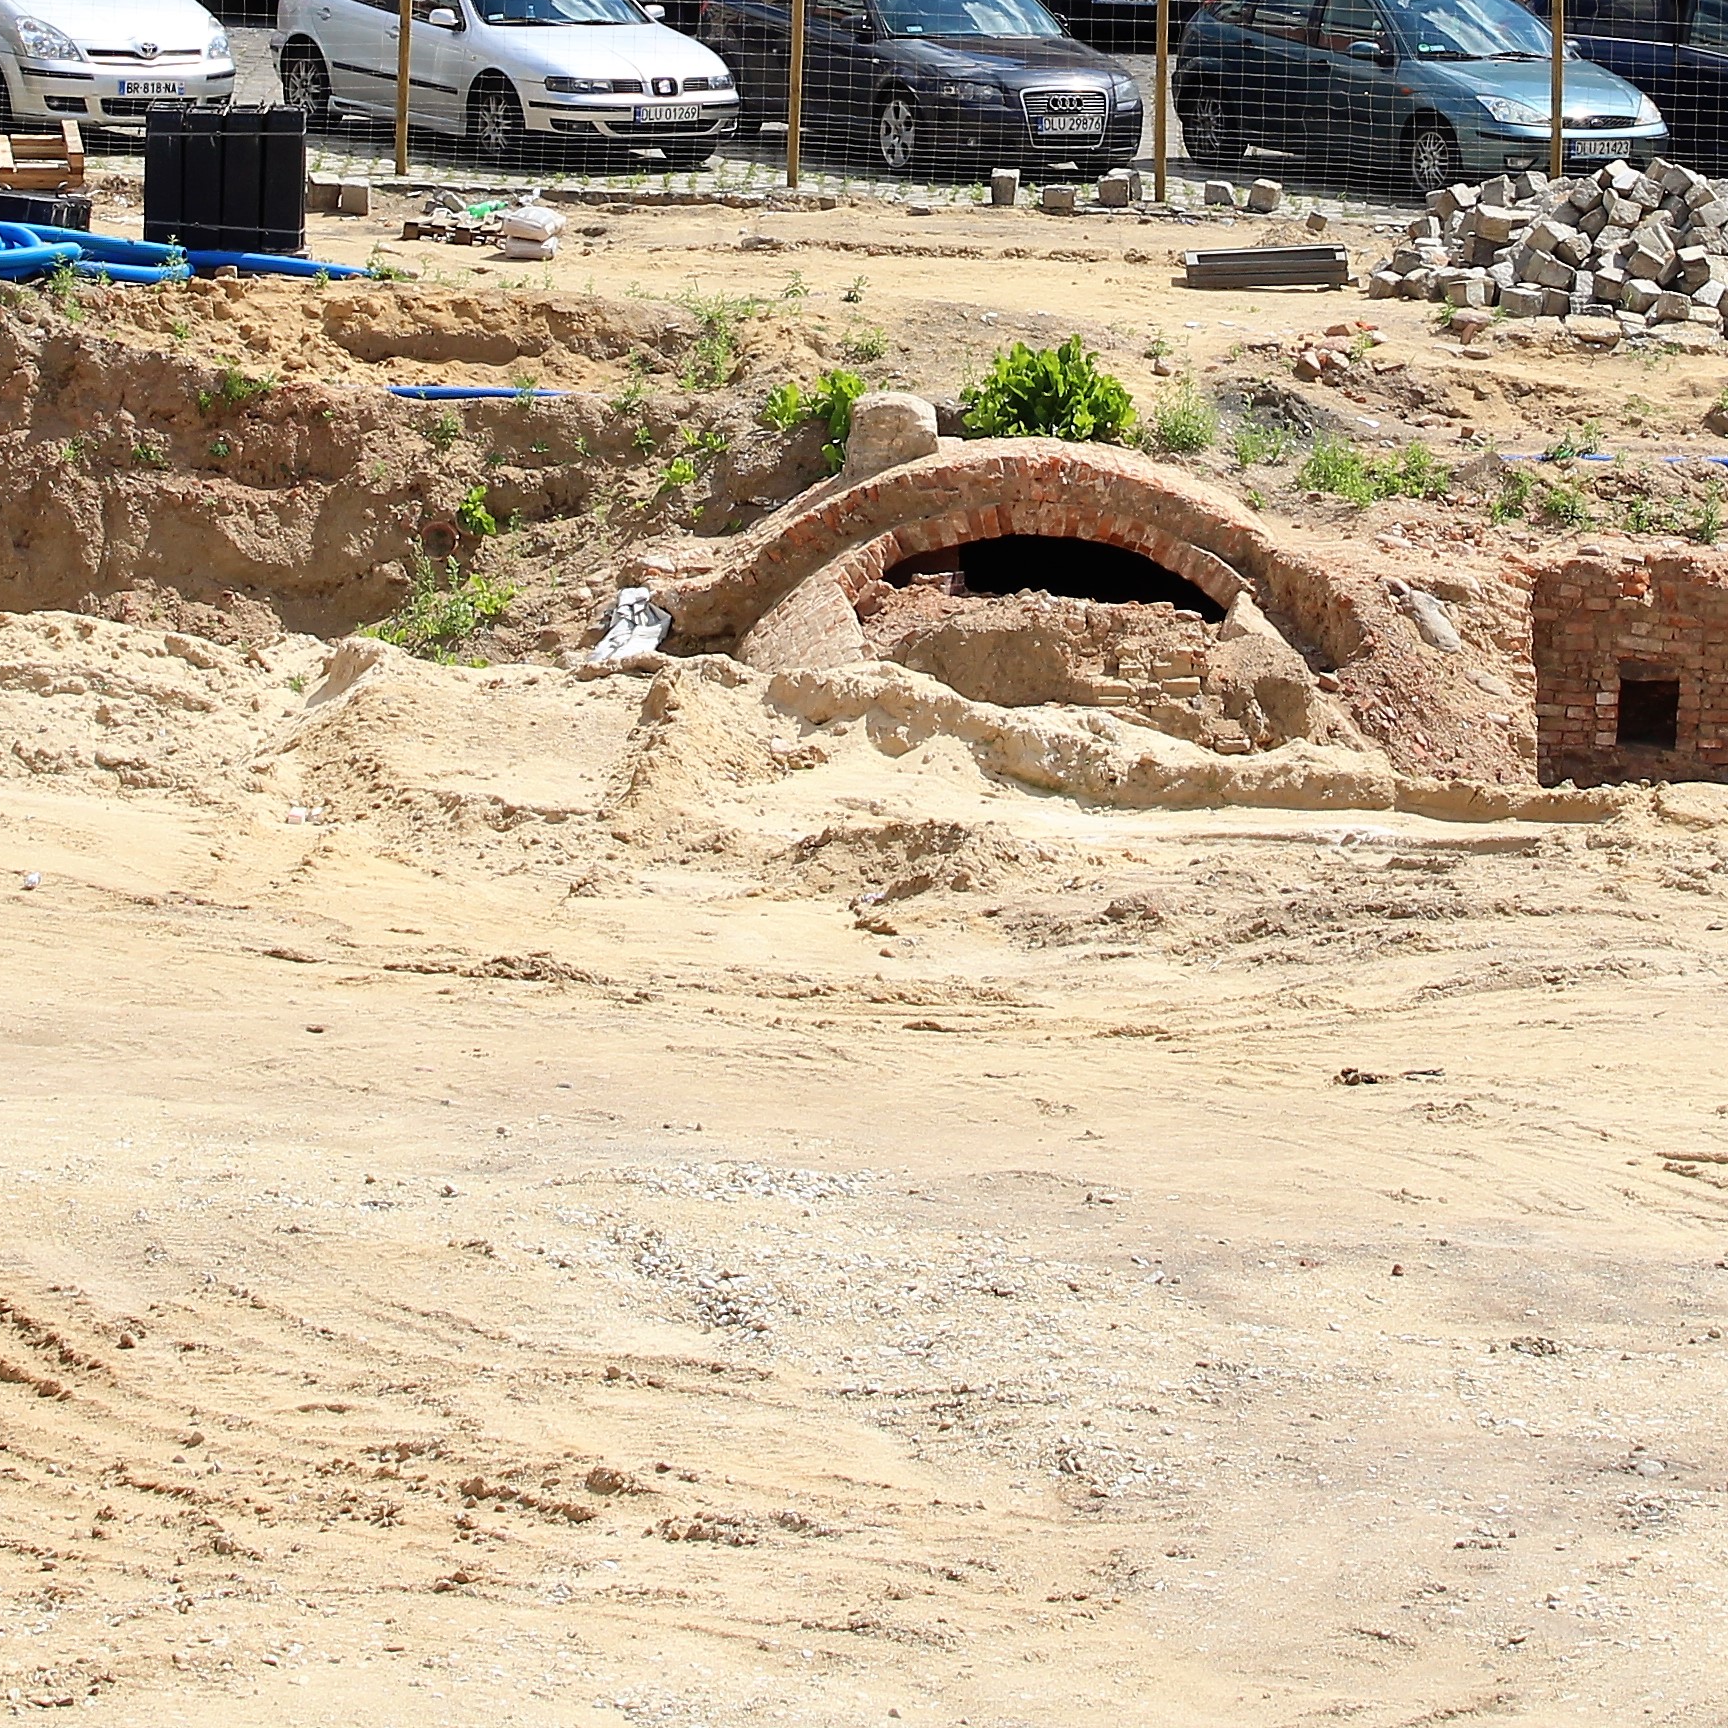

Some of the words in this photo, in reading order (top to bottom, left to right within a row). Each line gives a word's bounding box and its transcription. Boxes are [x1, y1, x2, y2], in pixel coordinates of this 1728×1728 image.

[641, 108, 663, 120] DLU
[665, 107, 697, 120] 01269
[1044, 118, 1066, 130] DLU
[1069, 117, 1101, 130] 29876
[1576, 141, 1598, 155] DLU
[1600, 141, 1630, 155] 21423
